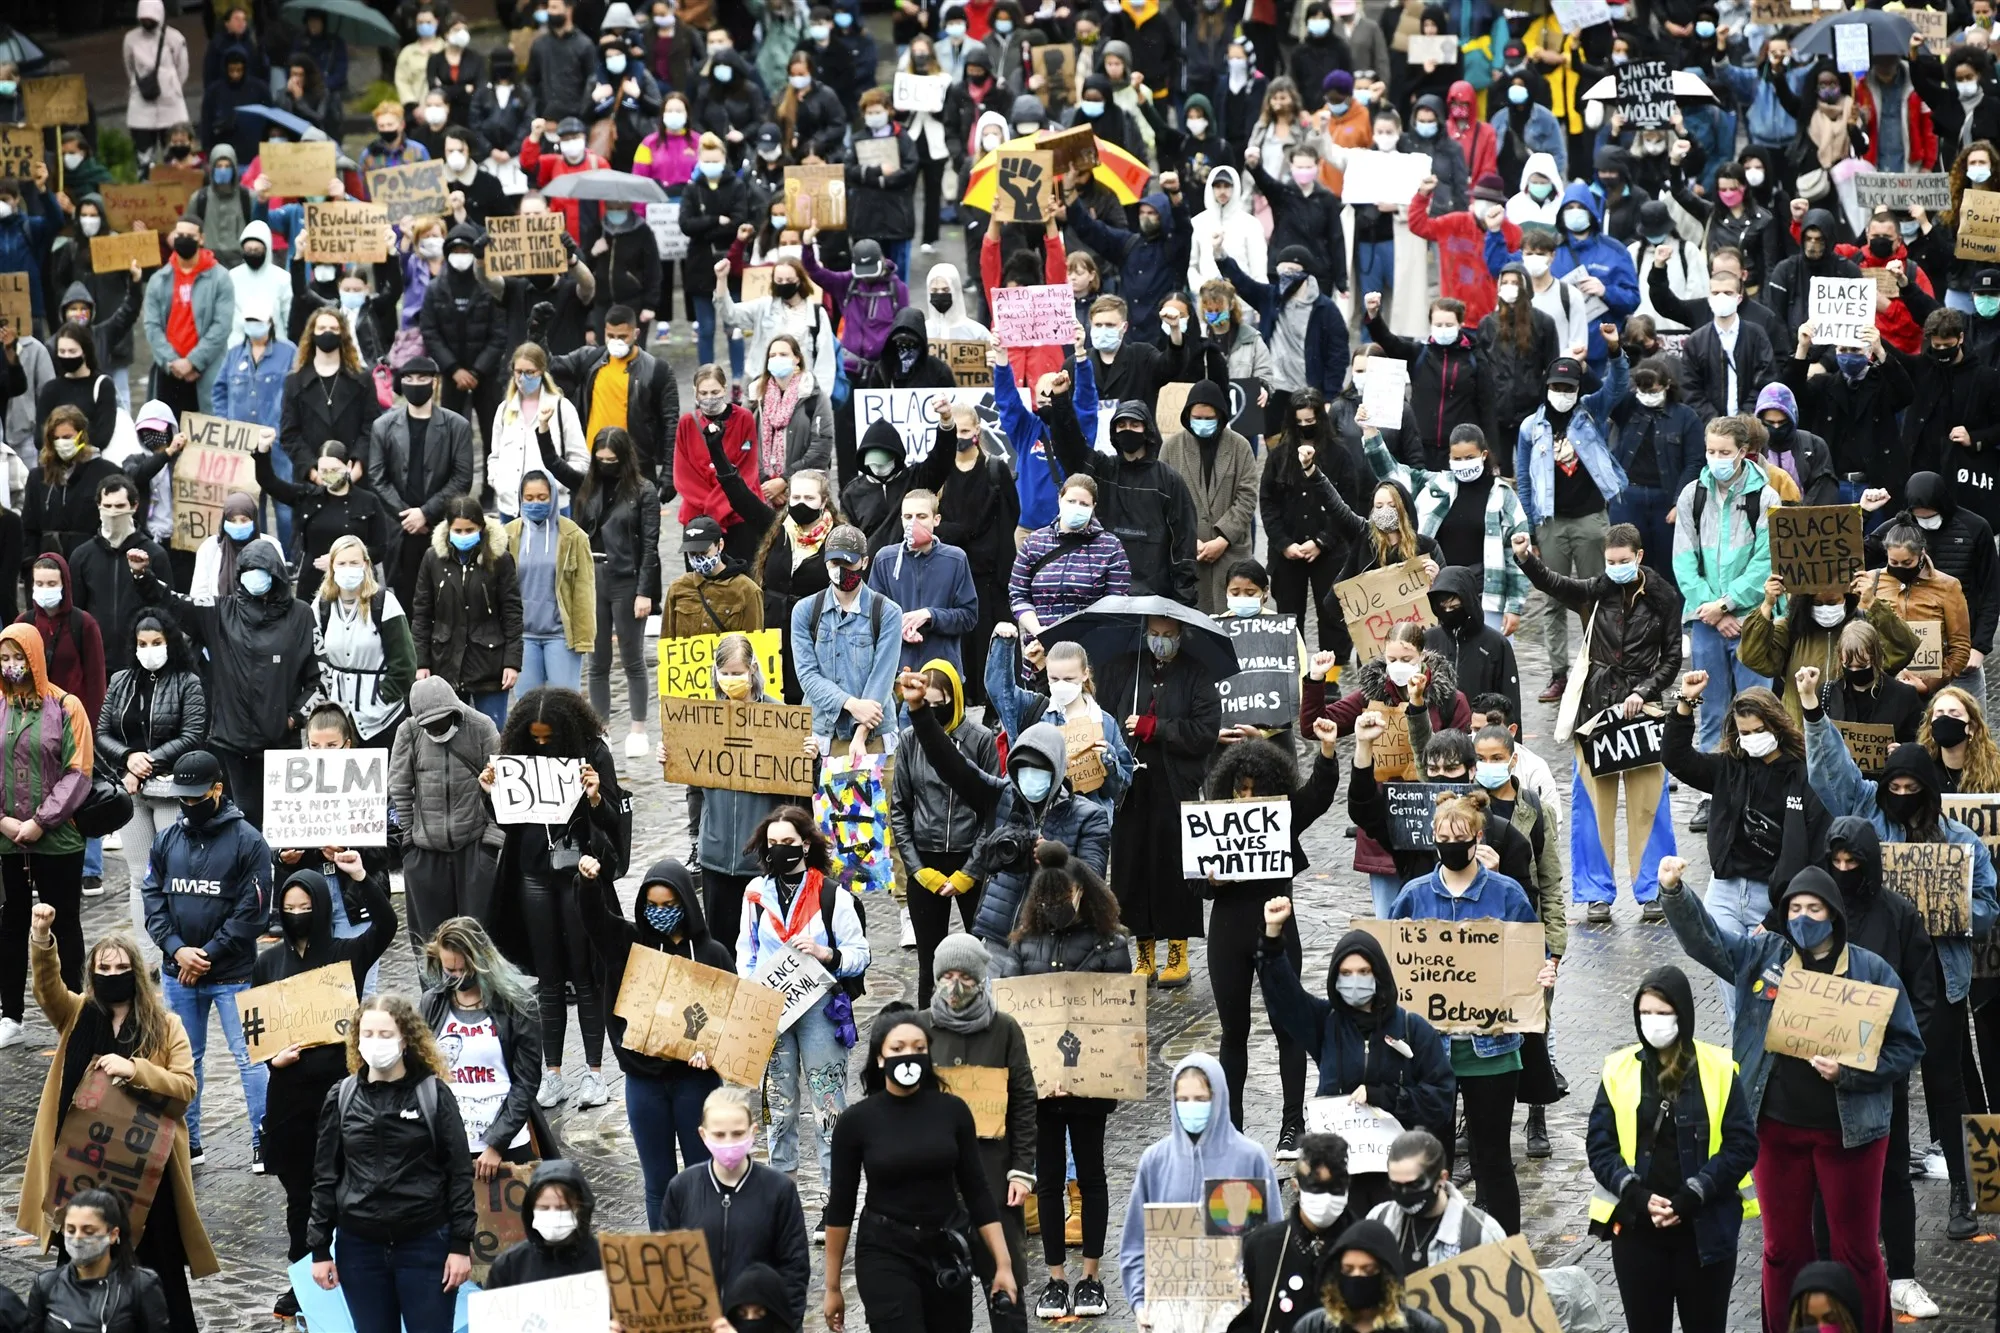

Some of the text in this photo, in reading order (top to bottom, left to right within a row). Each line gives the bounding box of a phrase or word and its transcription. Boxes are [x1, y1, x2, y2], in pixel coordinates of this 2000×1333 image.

[1898, 176, 1912, 188] NOT
[1857, 192, 1950, 206] BLACK LIVES MATTER
[487, 218, 521, 234] RIGHT
[310, 238, 356, 253] EVENT
[528, 234, 554, 251] TIME
[490, 255, 526, 272] RIGHT
[1014, 289, 1030, 301] 10
[1817, 284, 1869, 301] BLACK
[1817, 302, 1868, 317] LIVES
[1813, 322, 1863, 339] MATTE
[959, 345, 980, 356] END
[955, 371, 991, 386] TTER
[188, 418, 222, 446] WE
[197, 449, 242, 483] NOT
[178, 480, 200, 499] BE
[1775, 513, 1853, 539] BLACK
[1777, 538, 1851, 559] LIVES
[1778, 557, 1864, 586] MATTER
[1343, 569, 1425, 617] We all
[1220, 690, 1281, 714] THEIRS
[665, 703, 812, 731] WHITE SILENCE
[1593, 719, 1666, 769] MATTE
[1841, 727, 1895, 744] FREEDOM
[267, 756, 383, 794] #BLM
[685, 747, 814, 785] VIOLENCE
[496, 756, 582, 815] BLM
[1387, 787, 1423, 801] Racism
[309, 798, 341, 811] NOT
[299, 811, 341, 824] BLACK
[1186, 806, 1281, 838] BLACK
[266, 826, 332, 839] EVERYBODY
[1892, 844, 1965, 868] WORLD
[171, 877, 221, 895] MARS
[1439, 931, 1453, 943] a
[1457, 927, 1500, 945] time
[1410, 967, 1477, 983] silence
[1399, 987, 1413, 1002] is
[1784, 970, 1888, 1008] SILENCE
[446, 1022, 498, 1037] CAN'T
[1776, 1009, 1852, 1043] NOT AN
[1785, 1035, 1843, 1059] OPTION
[1146, 1208, 1182, 1231] IN
[1148, 1237, 1223, 1260] RACIST
[602, 1243, 712, 1285] BLACK
[1149, 1260, 1220, 1280] SOCIETY
[1149, 1280, 1180, 1297] NOT
[610, 1283, 708, 1315] LIVES
